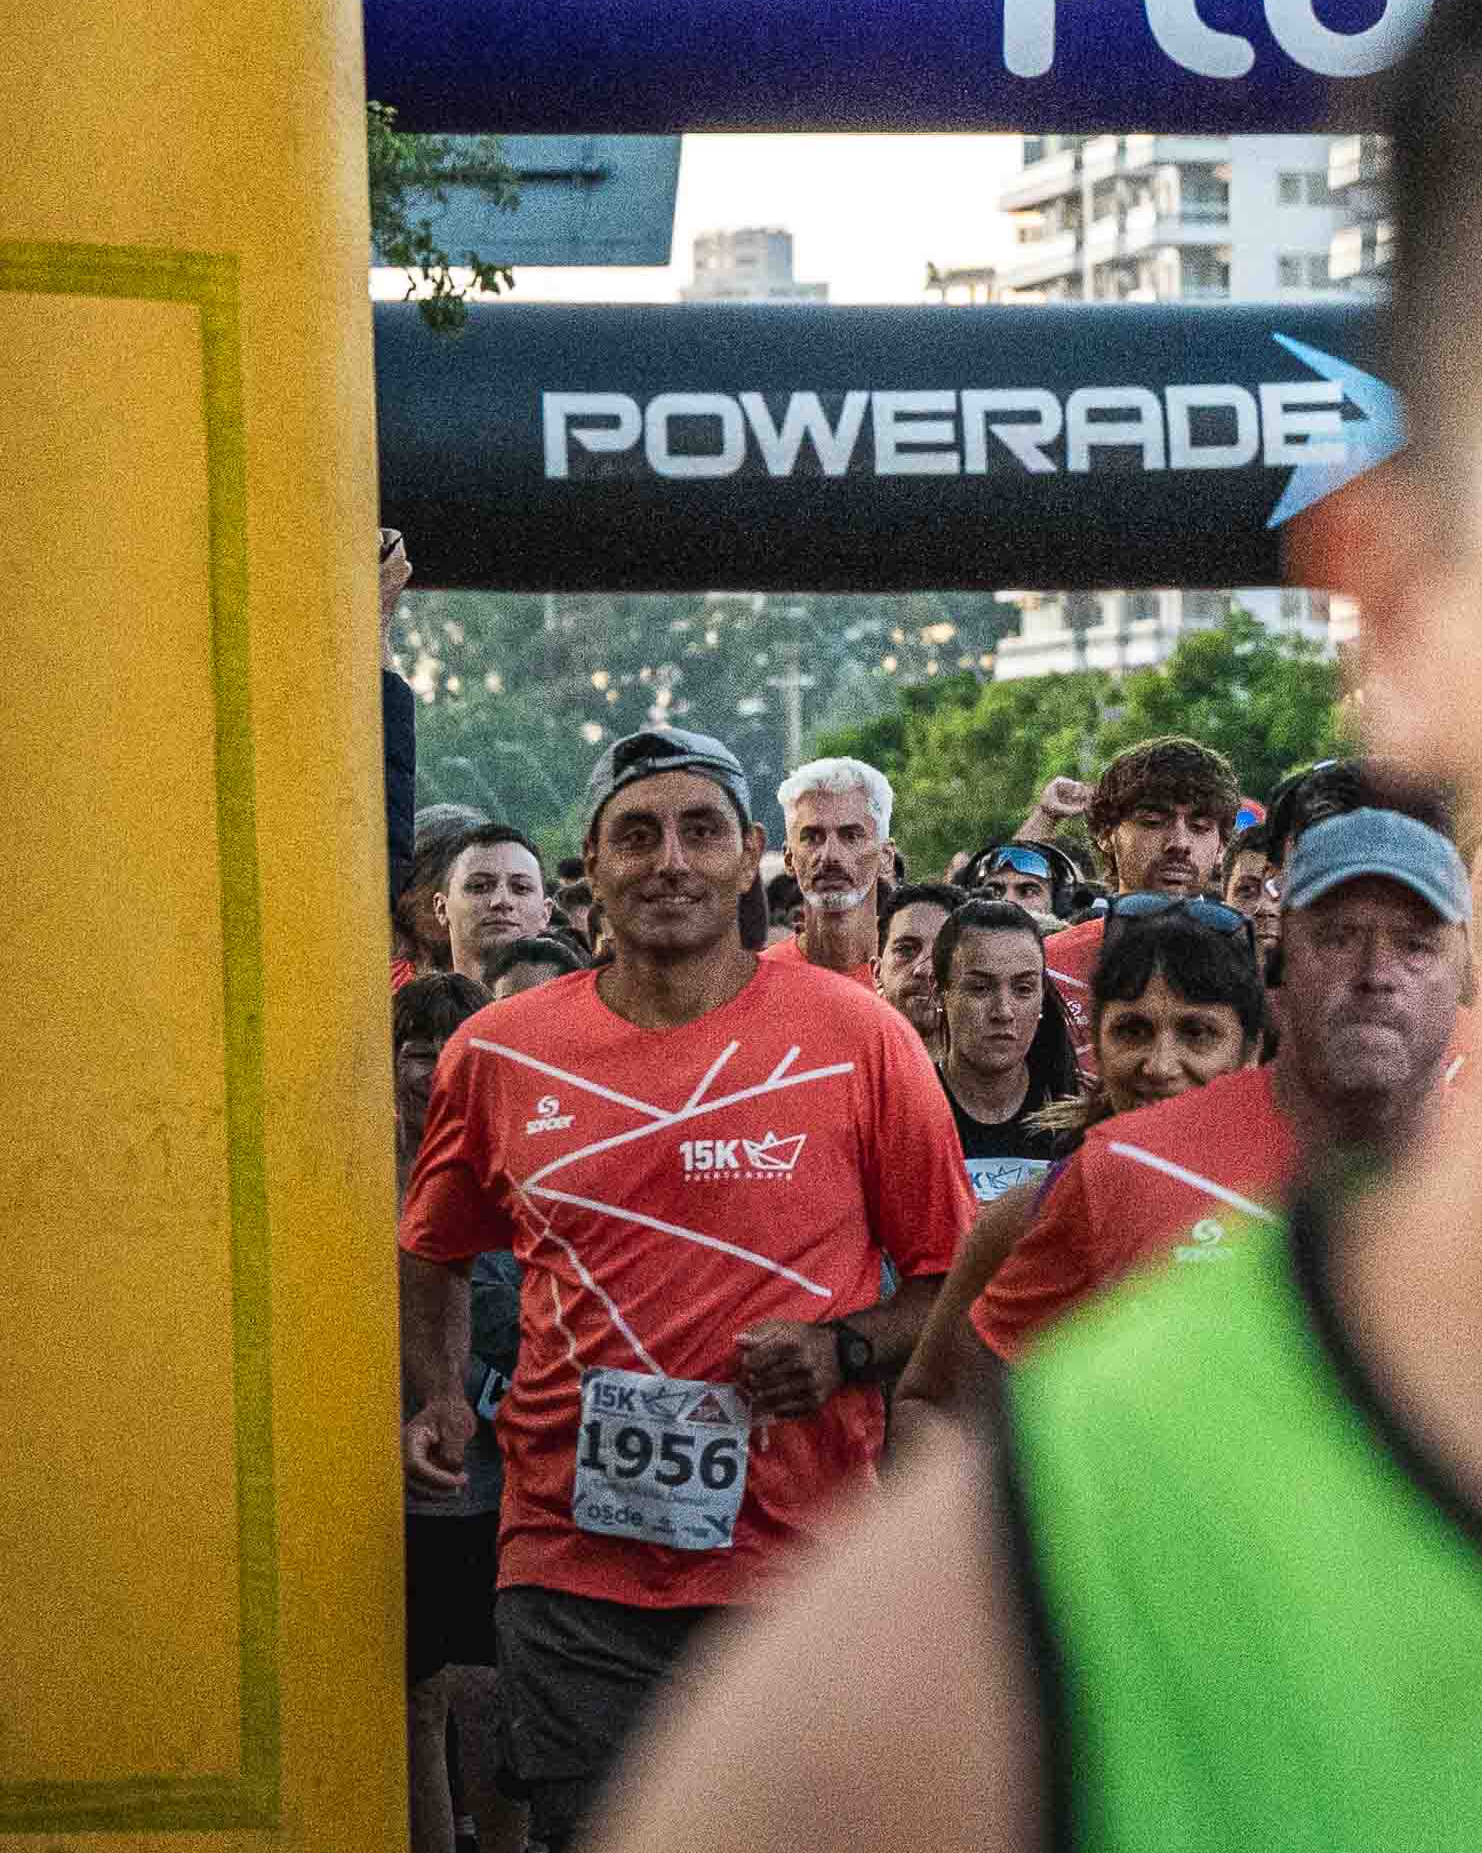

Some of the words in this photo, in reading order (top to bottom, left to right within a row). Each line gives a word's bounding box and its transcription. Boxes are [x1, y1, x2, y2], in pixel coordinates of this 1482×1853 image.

[541, 381, 1346, 481] POWERADE
[679, 1139, 740, 1171] 15K
[592, 1382, 636, 1411] 15K
[581, 1420, 738, 1489] 1956
